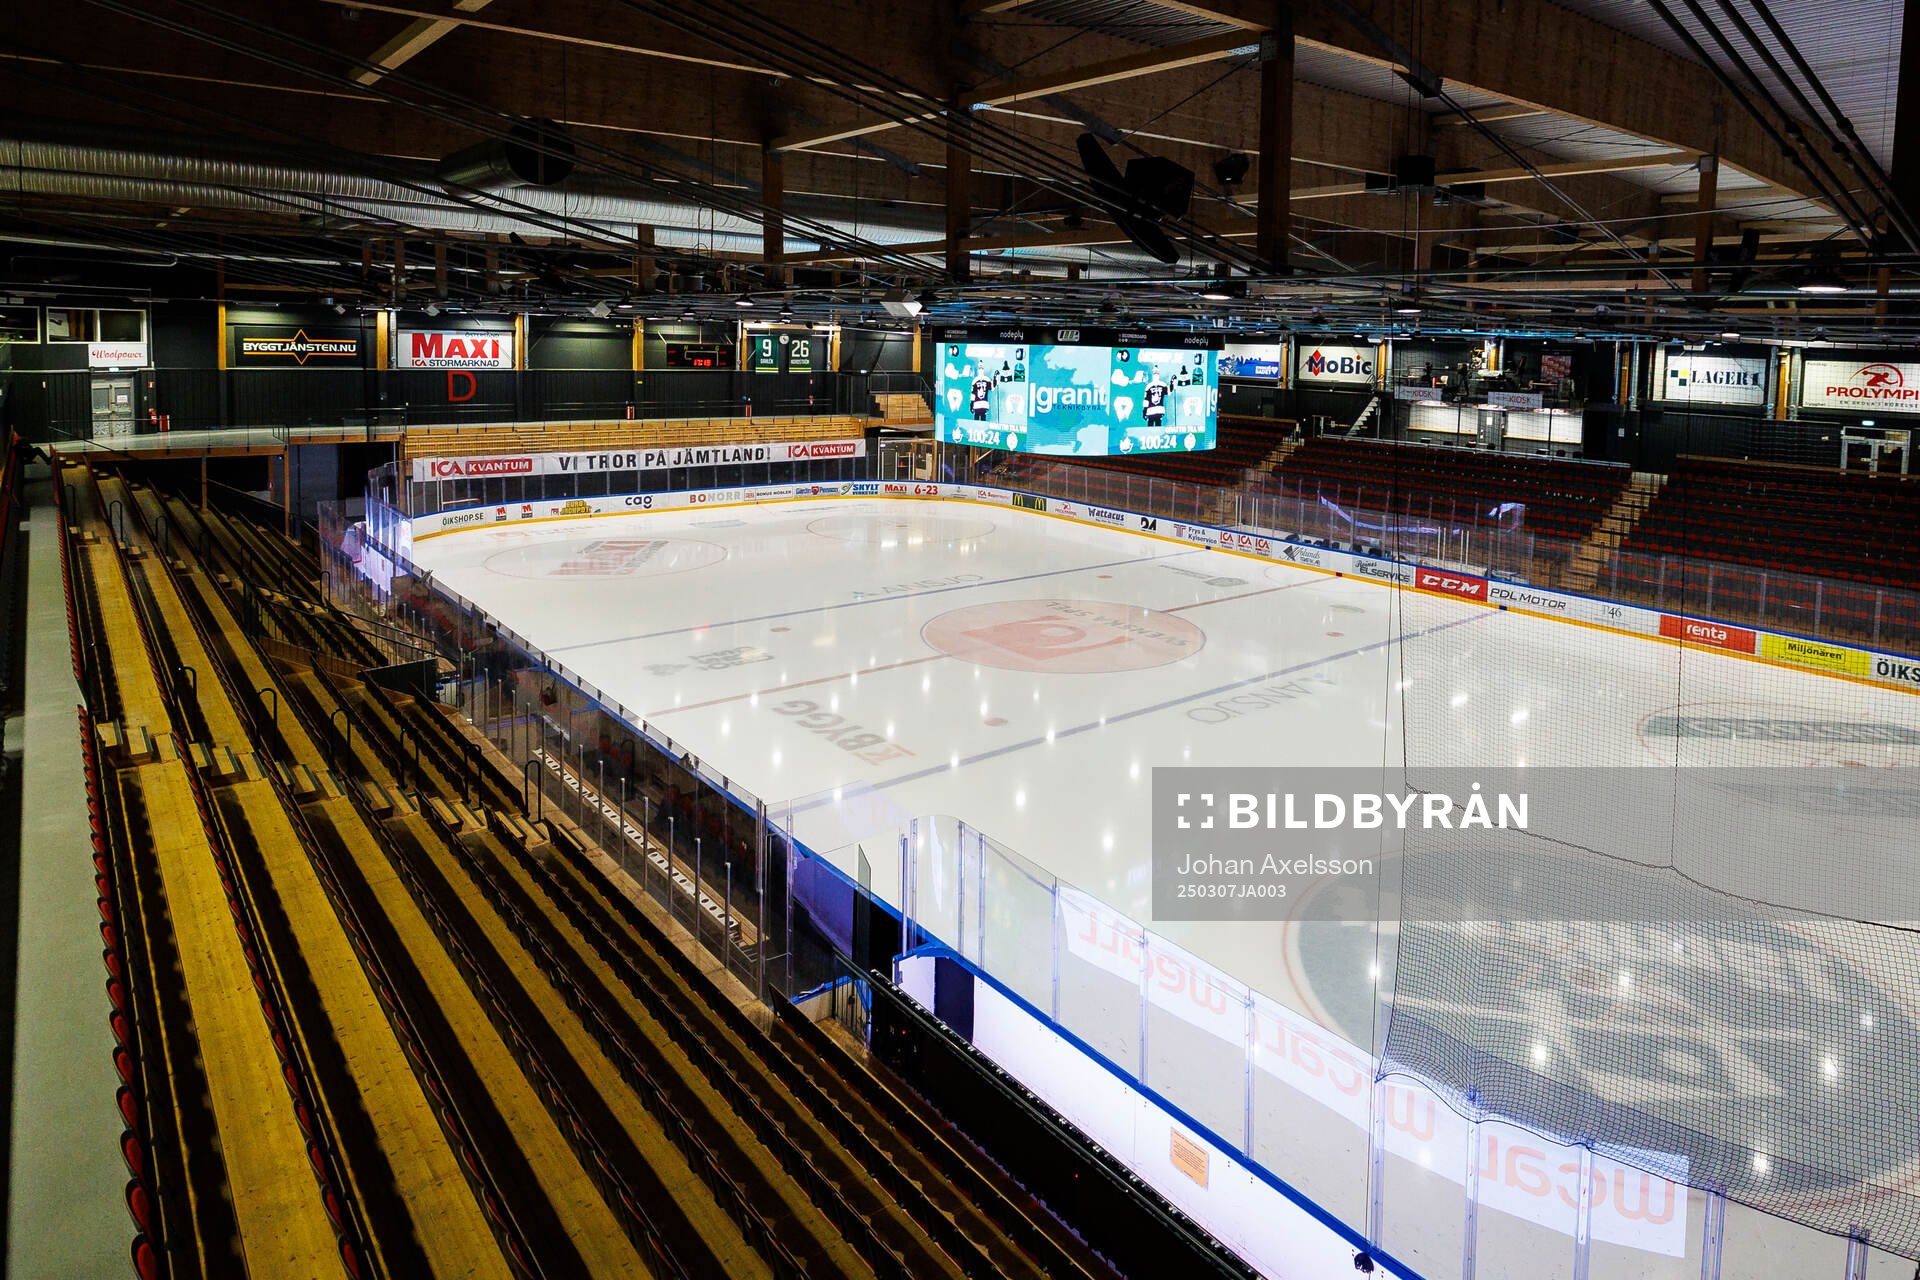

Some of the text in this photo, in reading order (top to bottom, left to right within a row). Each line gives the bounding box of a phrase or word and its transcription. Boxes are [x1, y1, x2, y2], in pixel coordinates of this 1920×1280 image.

[999, 329, 1024, 341] nodeply
[1184, 336, 1209, 346] nodeply
[242, 341, 357, 352] BYGGTJÄNSTEN.NU
[411, 332, 500, 359] MAXI
[762, 338, 772, 358] 9
[791, 339, 809, 358] 26
[91, 349, 144, 361] Woolpower
[428, 359, 500, 367] STORMARKNAD
[1307, 353, 1373, 376] MoBic
[447, 369, 477, 402] D
[1691, 370, 1749, 386] LAGER
[558, 446, 771, 471] VI TROR PÅ JÄMTLAND!
[788, 444, 854, 459] ICA KVANTUM
[431, 459, 530, 477] ICA KVANTUM
[853, 483, 880, 491] SKYLT
[884, 484, 939, 495] MAXI 6-23
[625, 494, 653, 510] cag
[689, 490, 741, 504] BONORR
[442, 511, 484, 526] ÖIKSHOP.SE
[1087, 506, 1125, 521] Wattacus
[1188, 526, 1201, 536] Frys
[1219, 531, 1234, 543] ICA
[1188, 533, 1218, 545] Kylservice
[1237, 534, 1252, 546] ICA
[1254, 537, 1270, 549] ICA
[1359, 566, 1411, 583] ELSERVICE
[1421, 574, 1481, 594] CCM
[1518, 593, 1567, 609] MOTOR
[1685, 624, 1728, 641] renta
[1787, 642, 1843, 660] Miljönären
